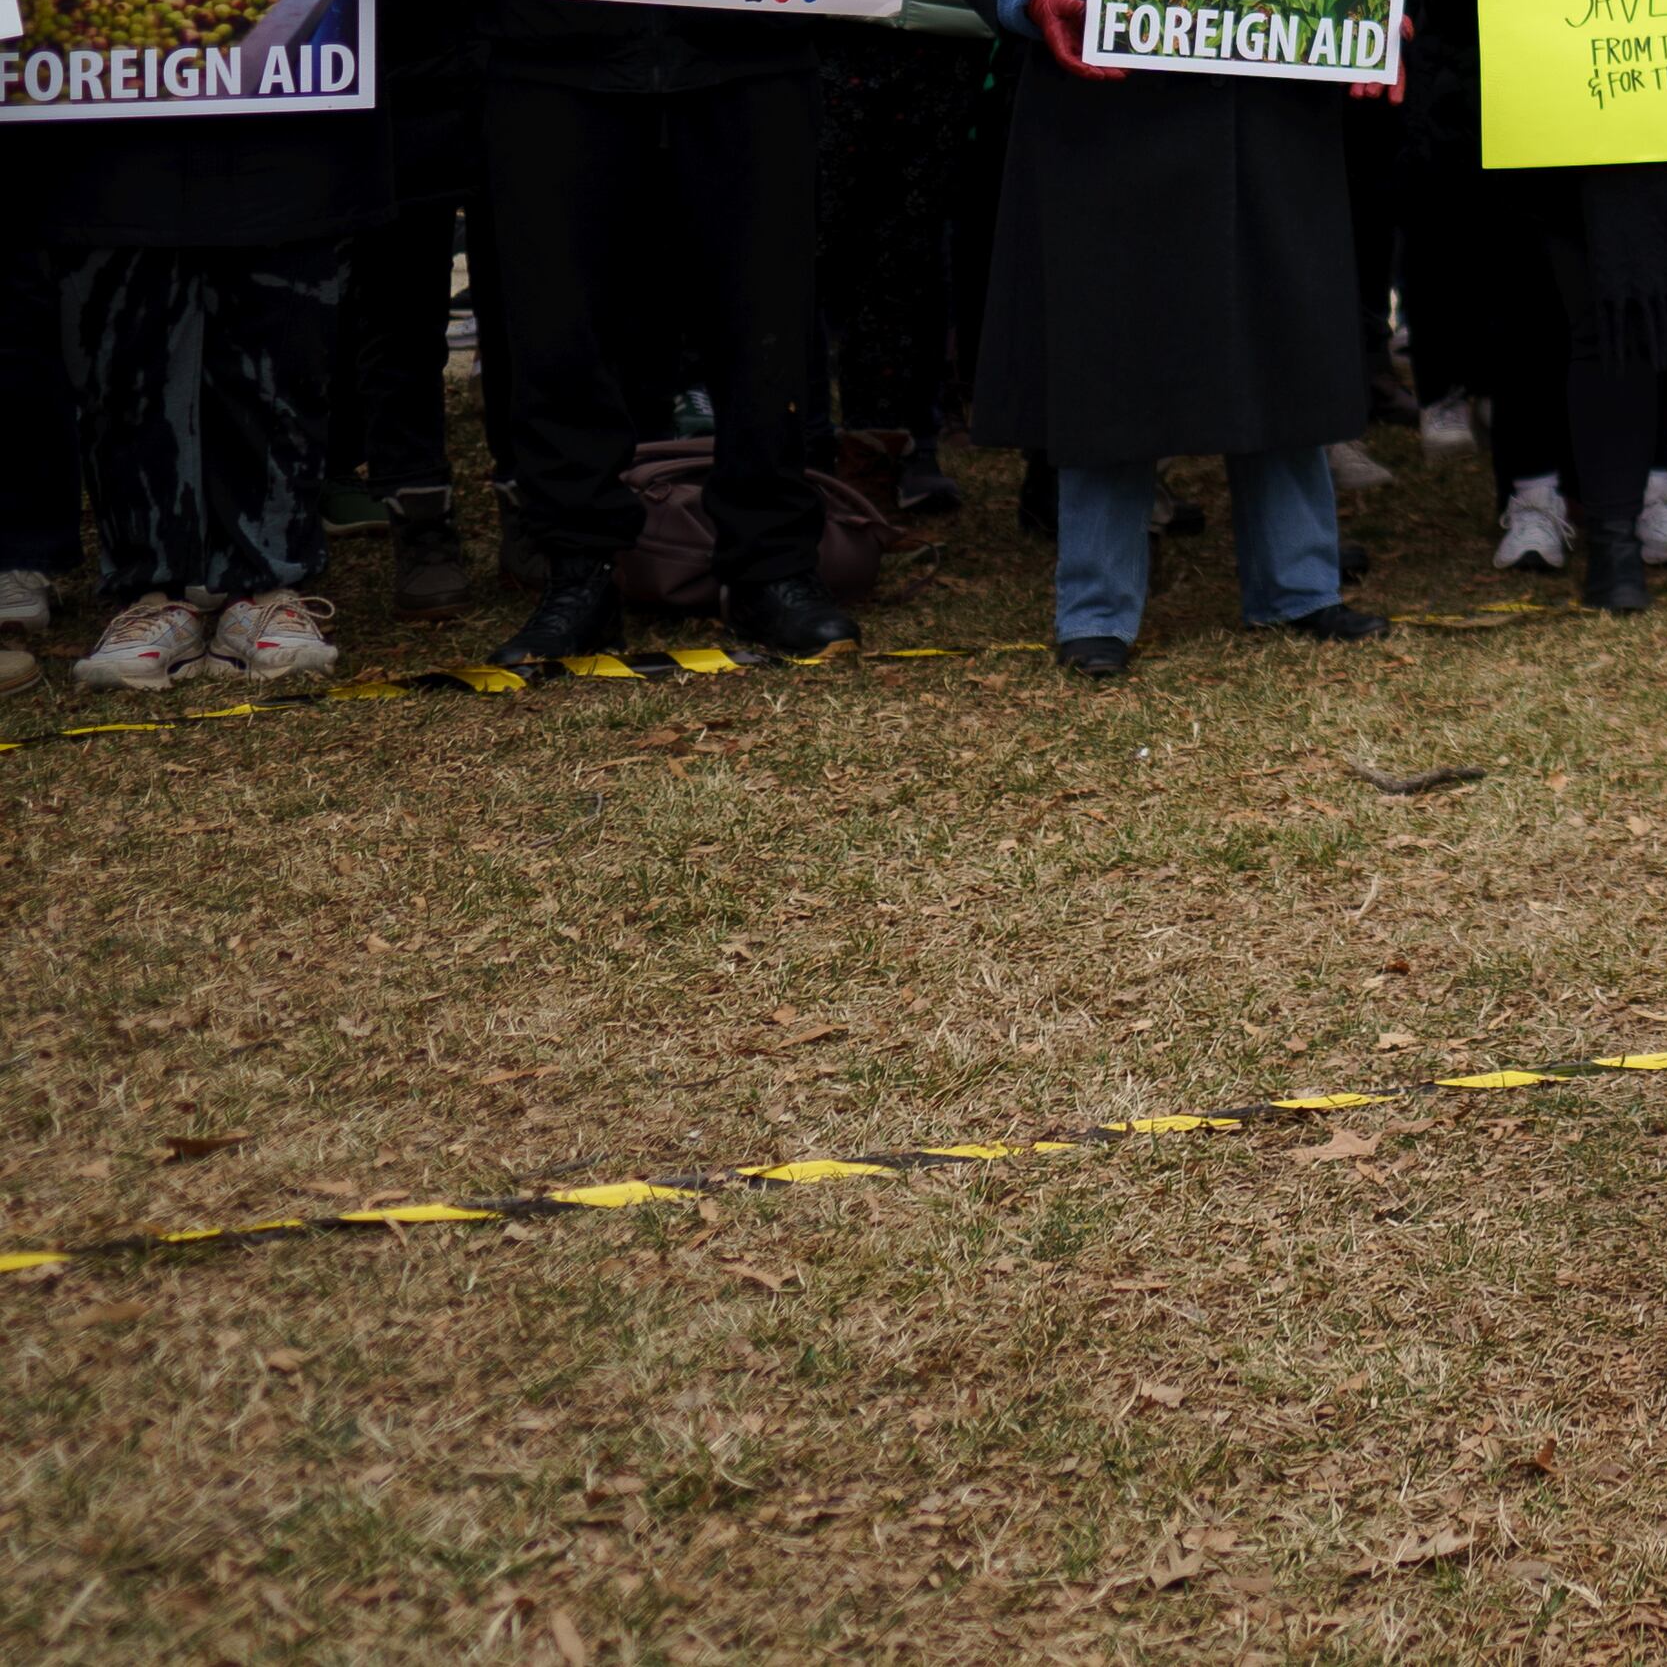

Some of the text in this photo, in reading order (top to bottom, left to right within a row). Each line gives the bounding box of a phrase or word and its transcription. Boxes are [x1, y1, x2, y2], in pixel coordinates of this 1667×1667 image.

[1102, 2, 1385, 68] FOREIGN AID
[1590, 35, 1653, 66] FROM
[0, 44, 356, 103] FOREIGN AID
[1588, 68, 1603, 111] &
[1607, 68, 1646, 99] FOR
